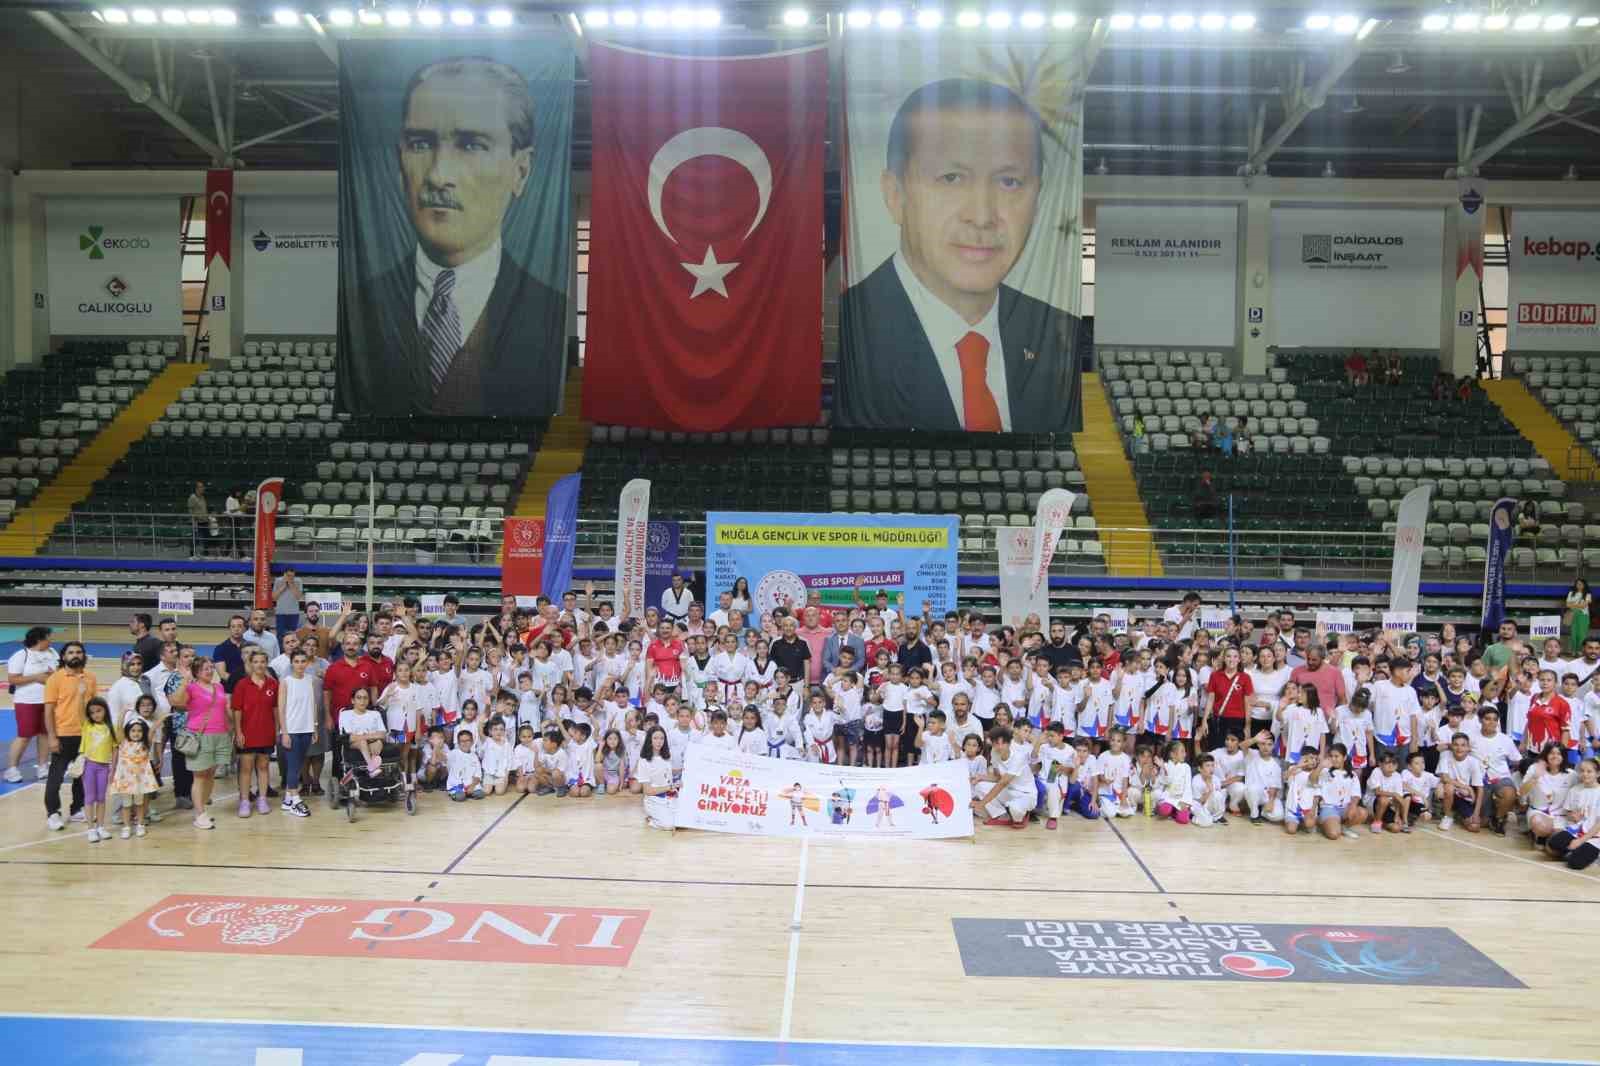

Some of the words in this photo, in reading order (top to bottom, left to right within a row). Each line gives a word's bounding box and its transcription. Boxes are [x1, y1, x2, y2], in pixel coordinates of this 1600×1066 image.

[1111, 238, 1160, 249] REKLAM
[1164, 239, 1221, 249] ALANIDIR
[1519, 304, 1595, 322] BODRUM
[721, 527, 759, 541] MUĞLA
[812, 531, 826, 541] VE
[828, 531, 858, 542] SPOR
[811, 577, 830, 587] GSB
[831, 576, 855, 586] SPOR
[862, 573, 901, 585] KULLARI
[65, 598, 96, 608] TENİS
[1326, 623, 1351, 632] SKETBOL
[349, 907, 637, 948] ING
[1007, 935, 1277, 951] BASKETBOL
